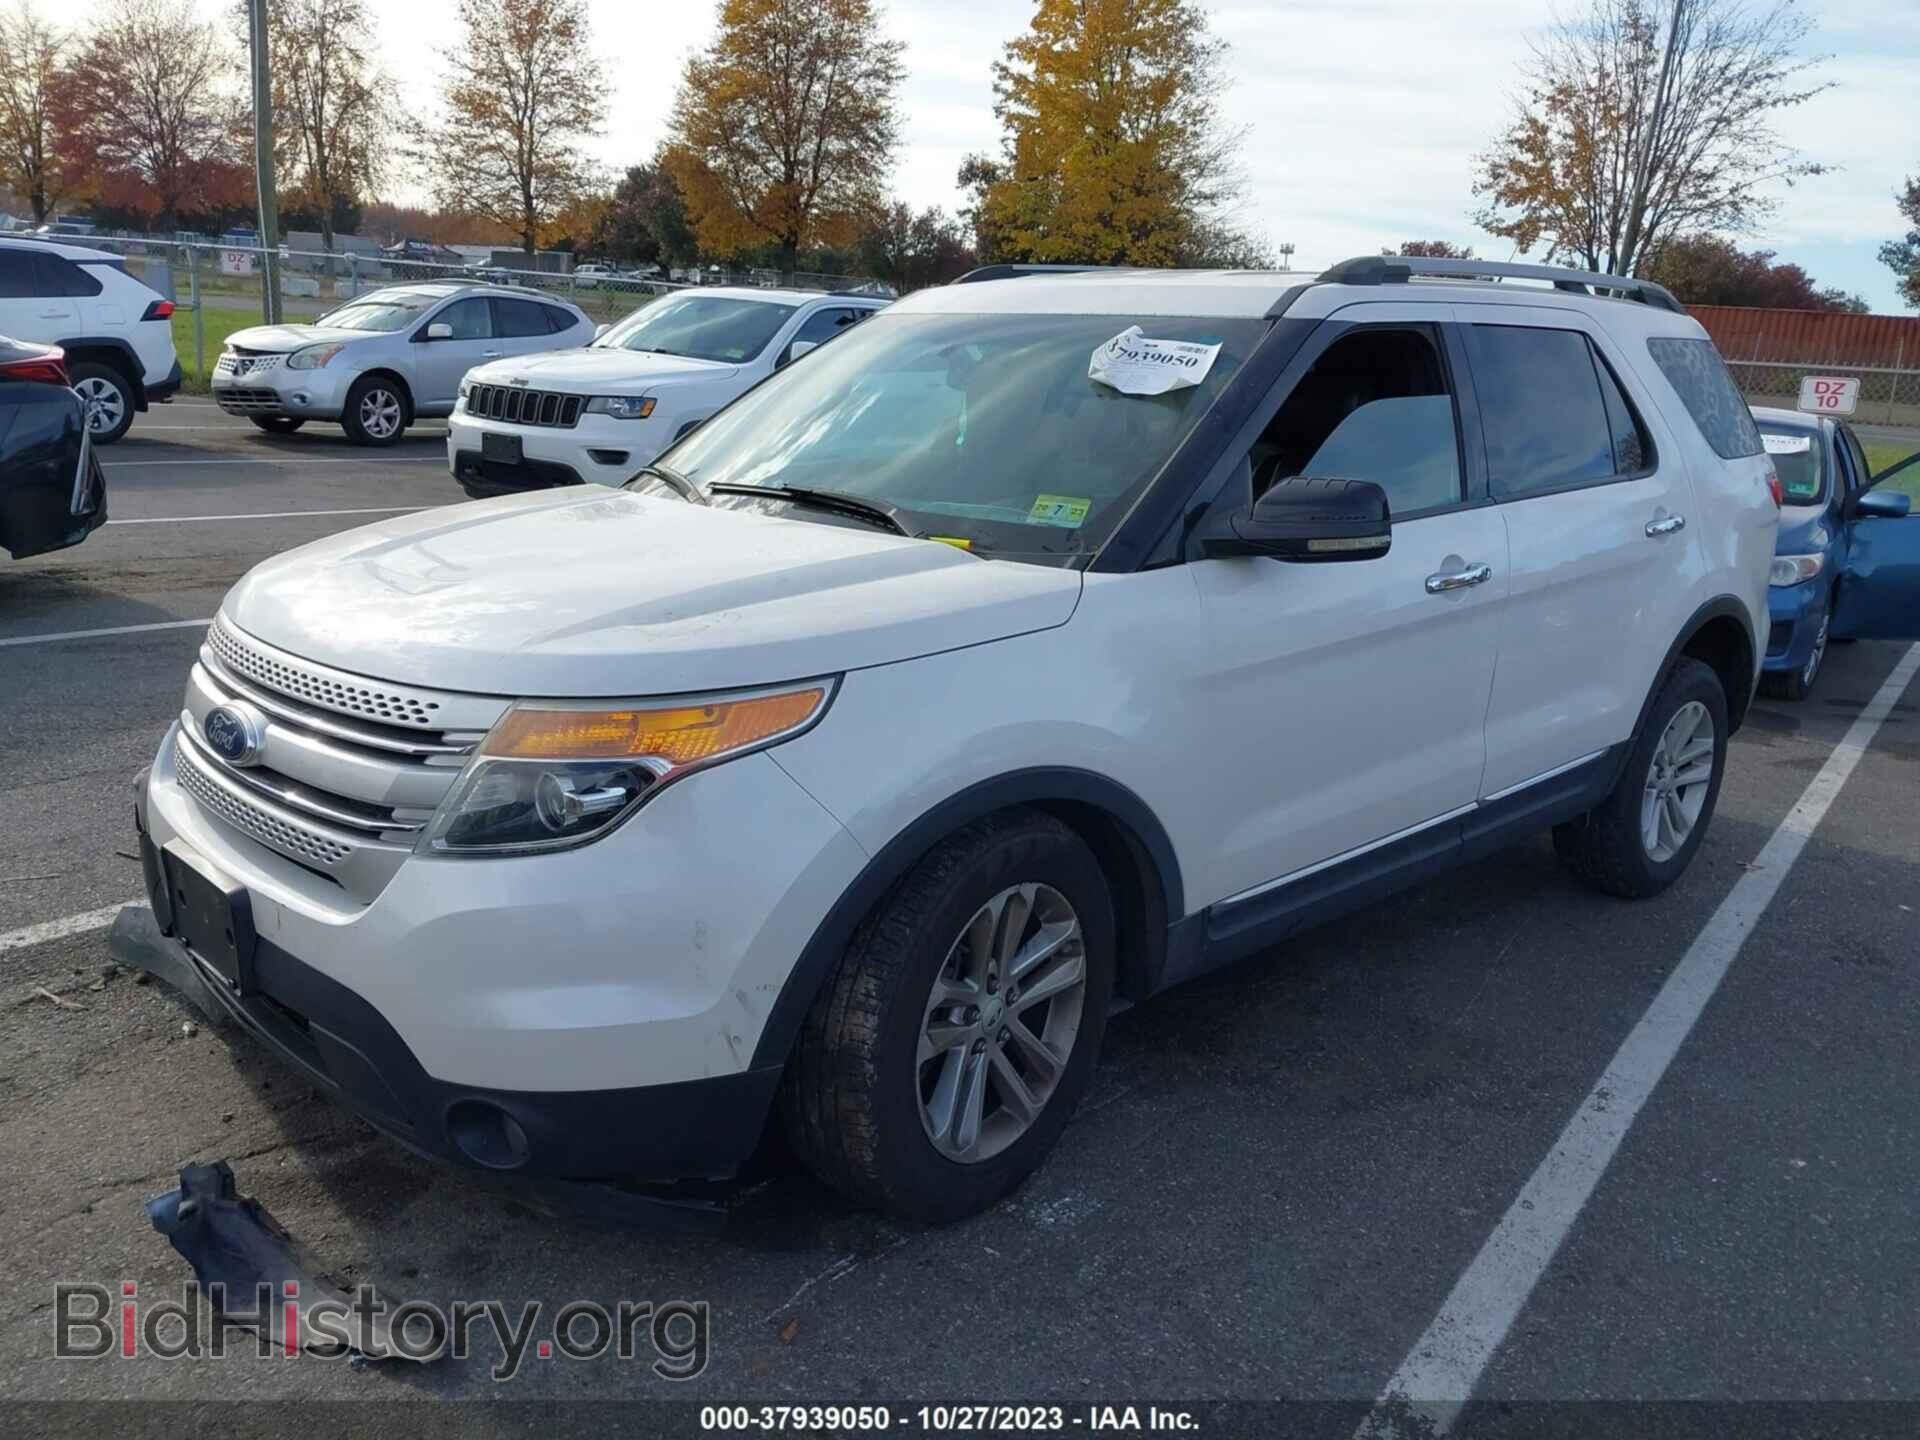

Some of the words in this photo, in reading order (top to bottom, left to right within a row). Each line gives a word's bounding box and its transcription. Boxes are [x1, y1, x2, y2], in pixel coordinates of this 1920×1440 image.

[1814, 381, 1847, 395] DZ
[1816, 395, 1839, 408] 10
[208, 712, 238, 751] Ford
